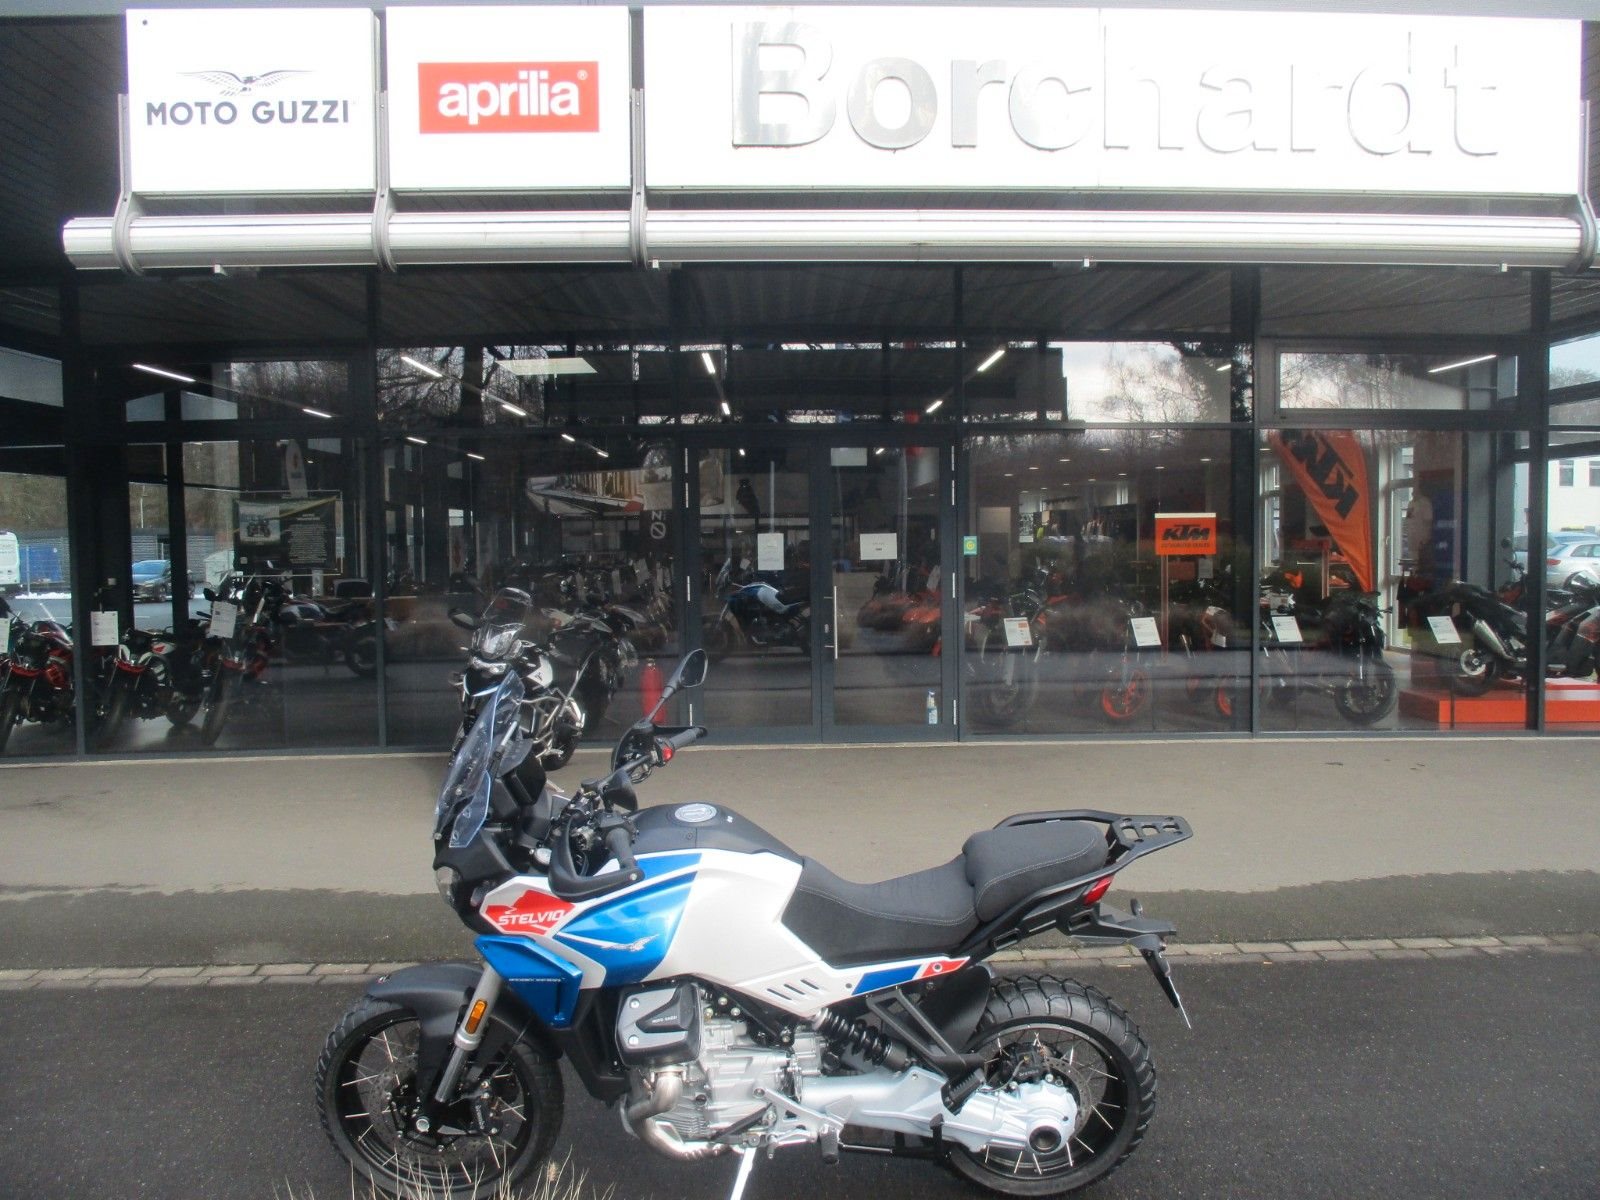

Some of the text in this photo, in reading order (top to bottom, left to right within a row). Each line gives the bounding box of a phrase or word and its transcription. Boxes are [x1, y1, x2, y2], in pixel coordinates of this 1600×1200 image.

[437, 71, 579, 125] aprilia
[731, 20, 1499, 157] Borchardt
[147, 101, 349, 125] MOTO GUZZI
[1162, 523, 1210, 541] KTM
[497, 910, 565, 926] STELVIO
